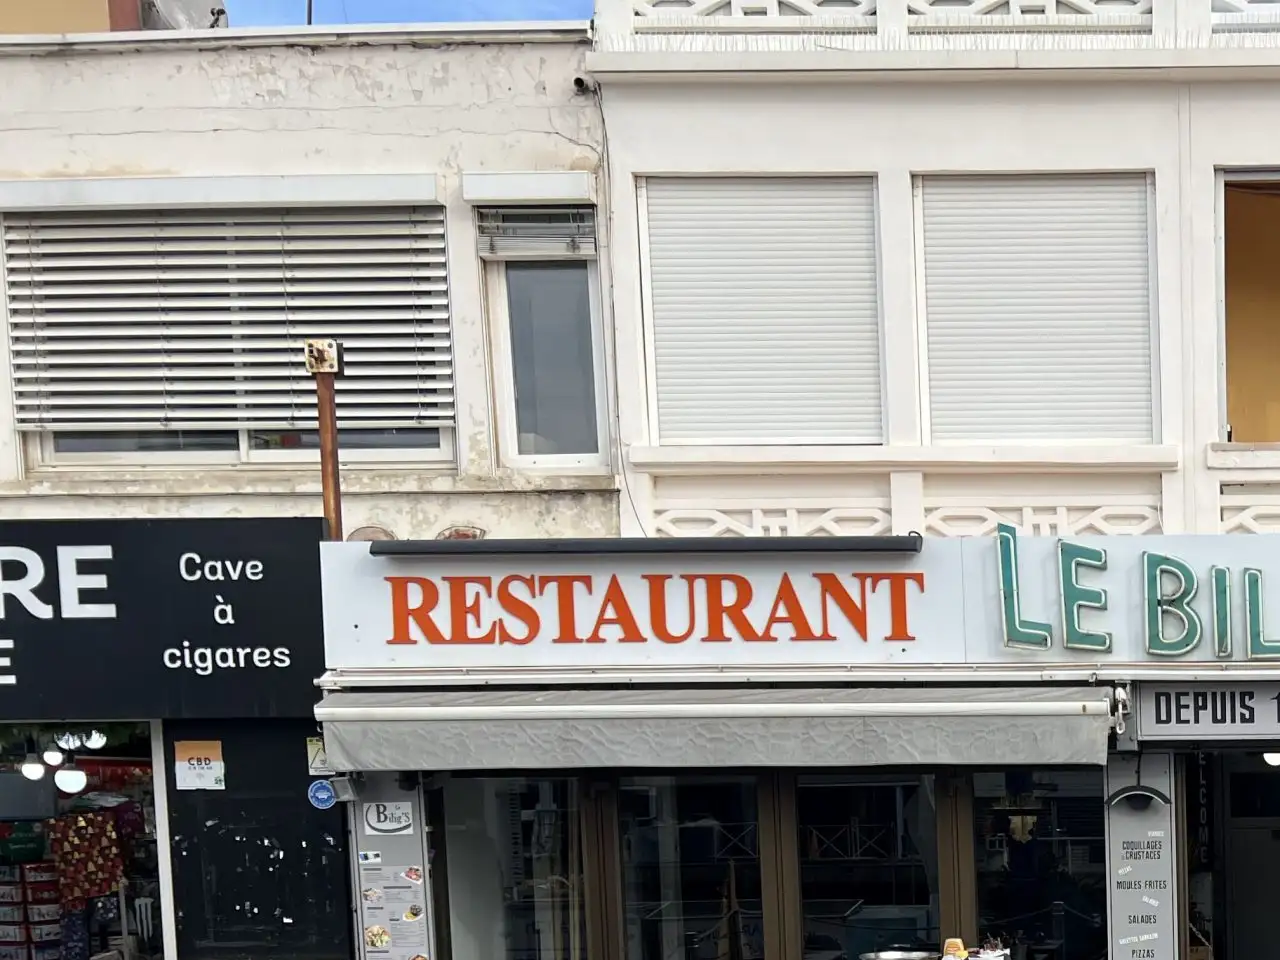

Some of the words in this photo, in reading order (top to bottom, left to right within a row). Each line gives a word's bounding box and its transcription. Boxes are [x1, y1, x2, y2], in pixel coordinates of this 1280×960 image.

[178, 552, 264, 582] Cave
[996, 522, 1112, 654] LE
[213, 594, 235, 625] à
[383, 571, 925, 646] RESTAURANT
[162, 640, 292, 676] cigares
[1154, 690, 1255, 725] DEPUIS
[188, 756, 211, 767] CBD
[1122, 840, 1162, 850] COQUILLAGES
[1116, 880, 1142, 890] MOULES
[1144, 880, 1167, 890] FRITES
[1128, 915, 1157, 925] SALADES
[1131, 949, 1155, 959] PIZZAS
